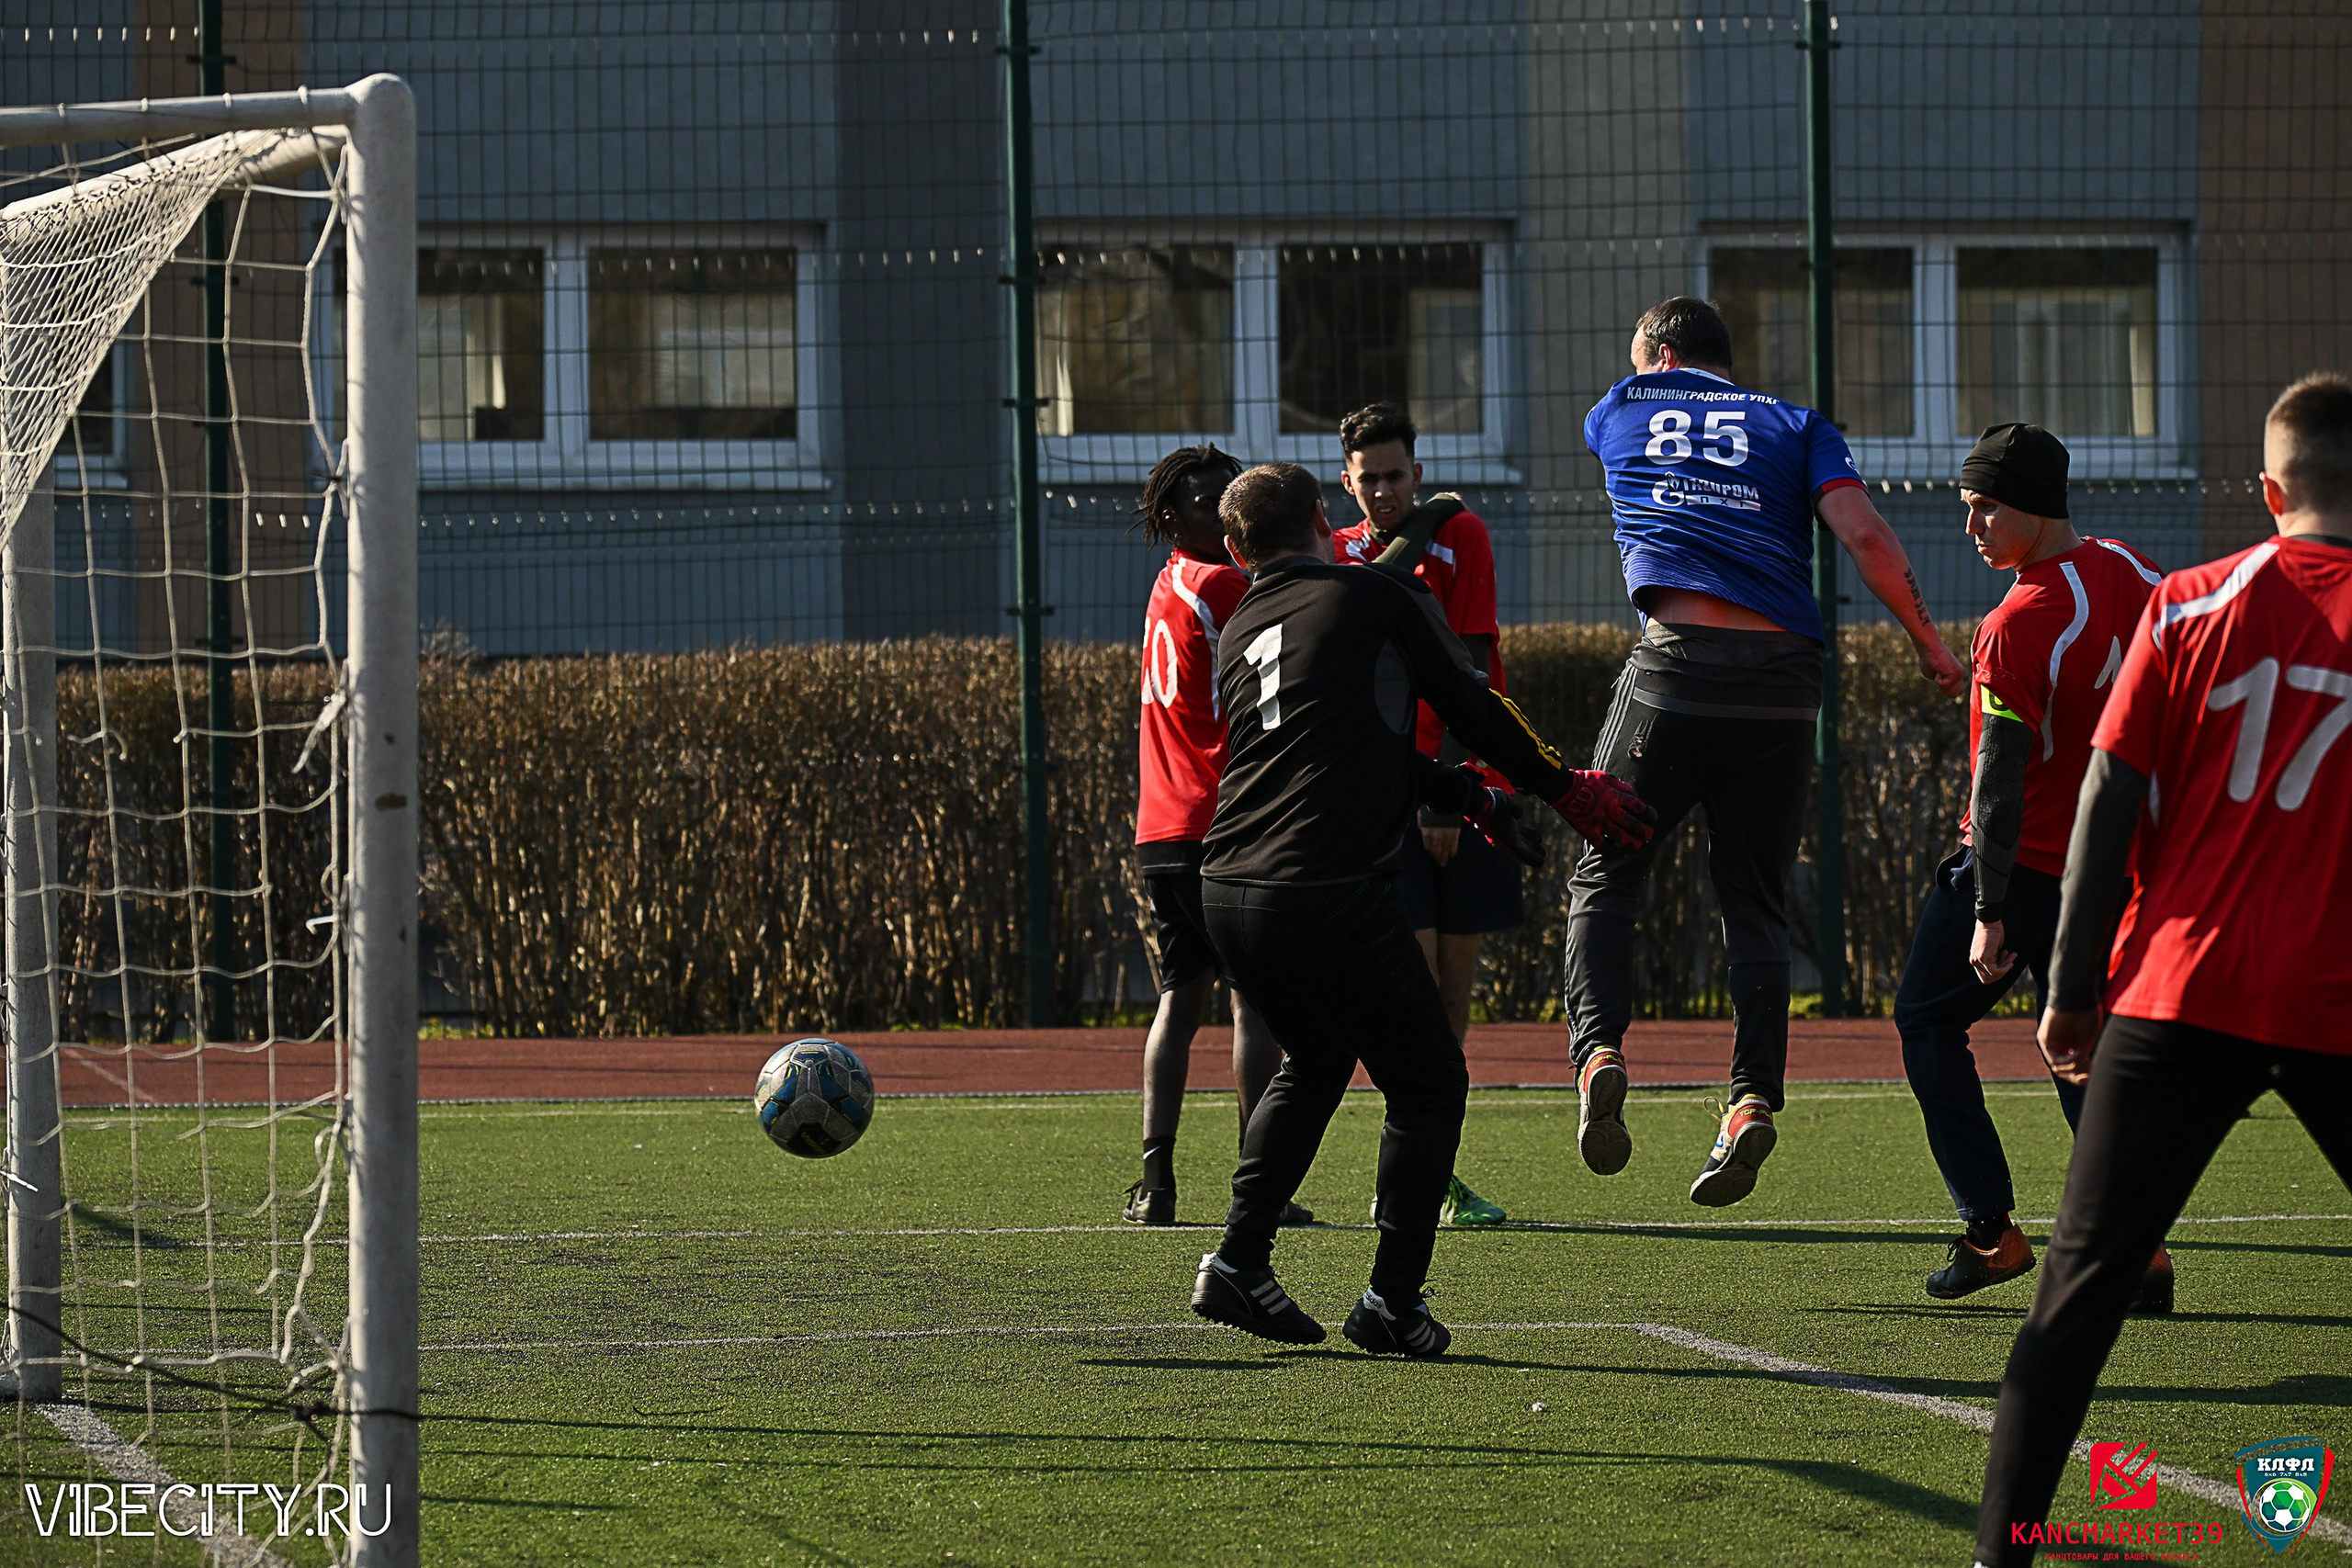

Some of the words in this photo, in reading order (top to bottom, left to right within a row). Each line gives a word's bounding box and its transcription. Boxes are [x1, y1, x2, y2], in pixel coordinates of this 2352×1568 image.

[1627, 387, 1746, 402] КАЛИНИНГРАДСКОЕ
[1645, 410, 1748, 467] 85
[1243, 623, 1283, 730] 1
[2207, 656, 2352, 811] 17
